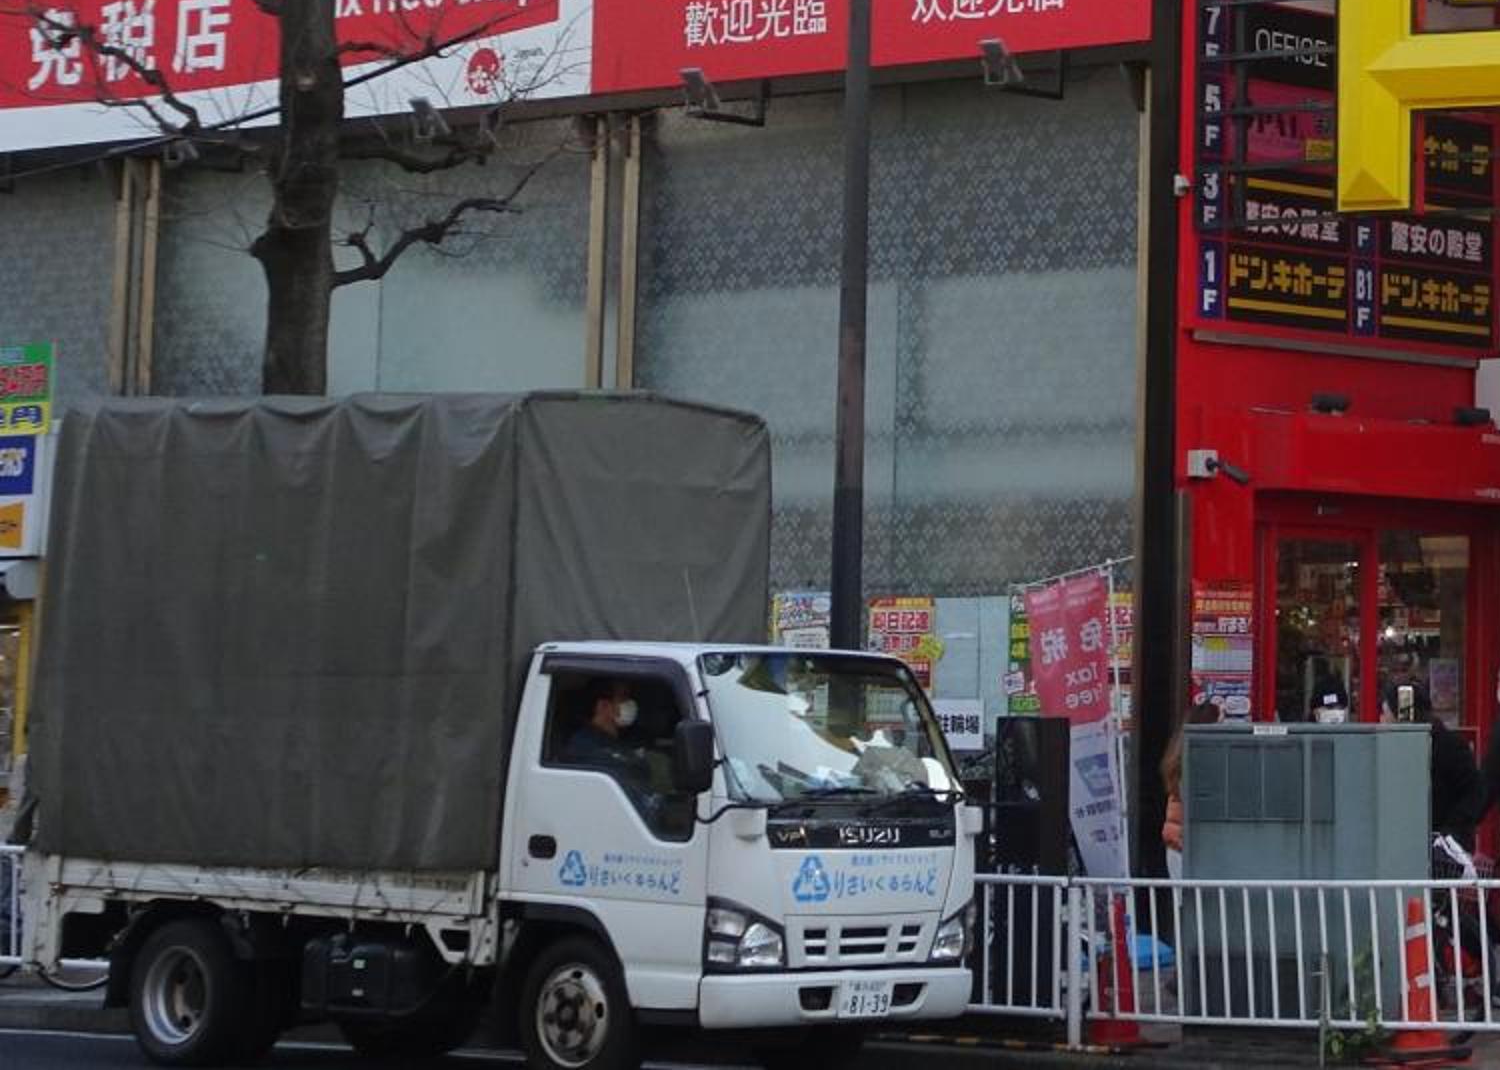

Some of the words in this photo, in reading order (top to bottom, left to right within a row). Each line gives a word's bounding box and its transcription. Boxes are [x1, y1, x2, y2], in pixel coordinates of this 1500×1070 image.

[1256, 28, 1329, 67] OFFICE
[1391, 220, 1483, 263] 驚安の殿堂
[839, 826, 900, 844] ISUZU
[832, 867, 938, 897] りさいくるらんど
